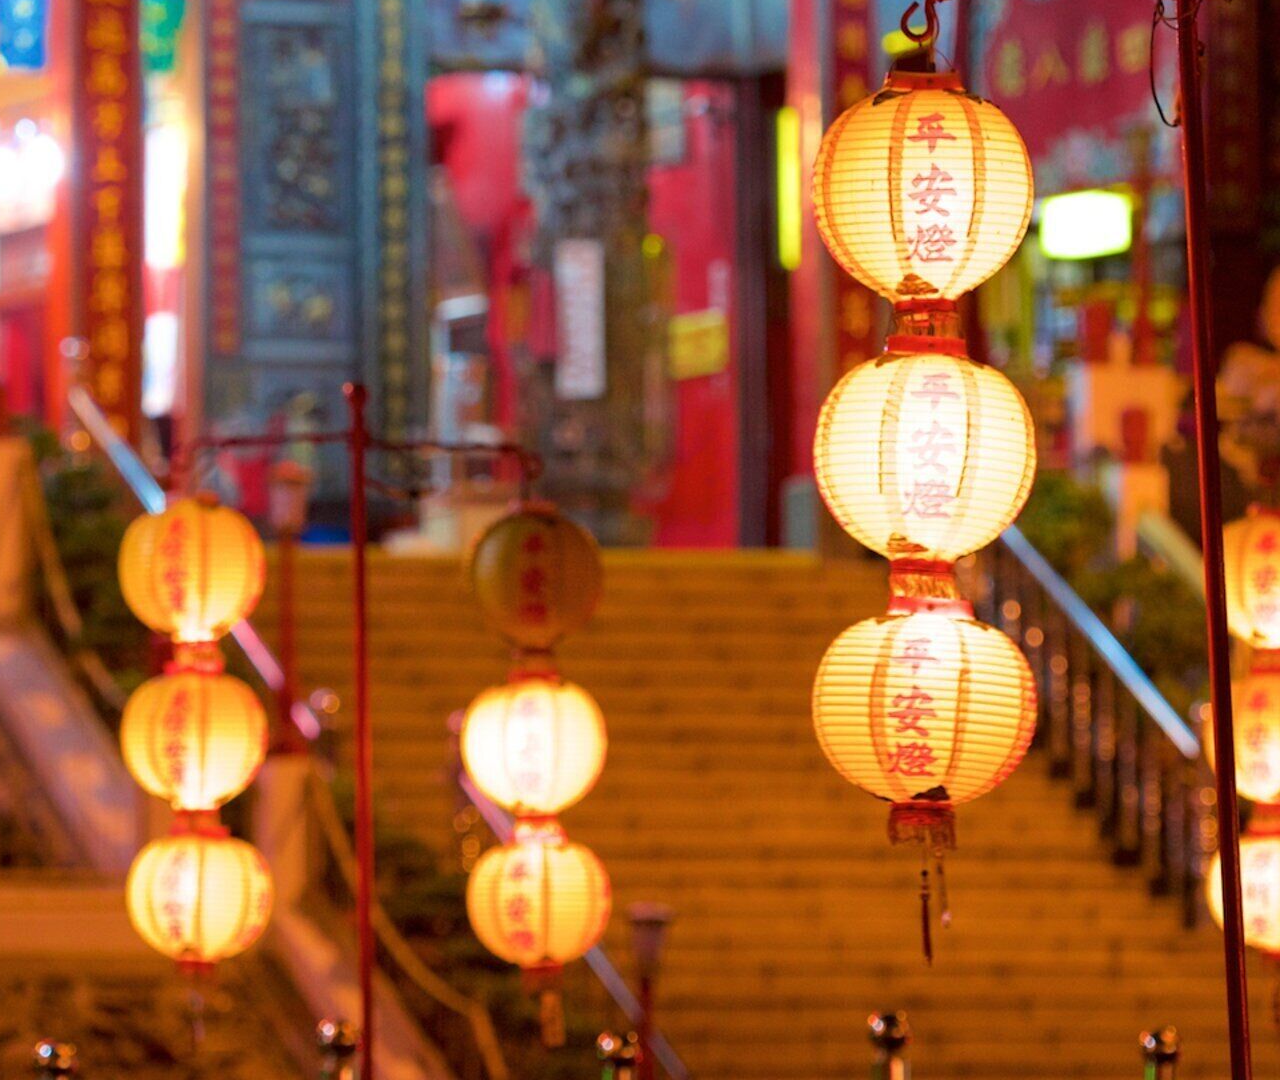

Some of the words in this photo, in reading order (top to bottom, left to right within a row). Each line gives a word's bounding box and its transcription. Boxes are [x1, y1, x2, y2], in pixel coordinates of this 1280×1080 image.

[905, 111, 958, 264] 平安燈
[903, 372, 961, 520] 平安燈
[887, 636, 941, 778] 平安燈
